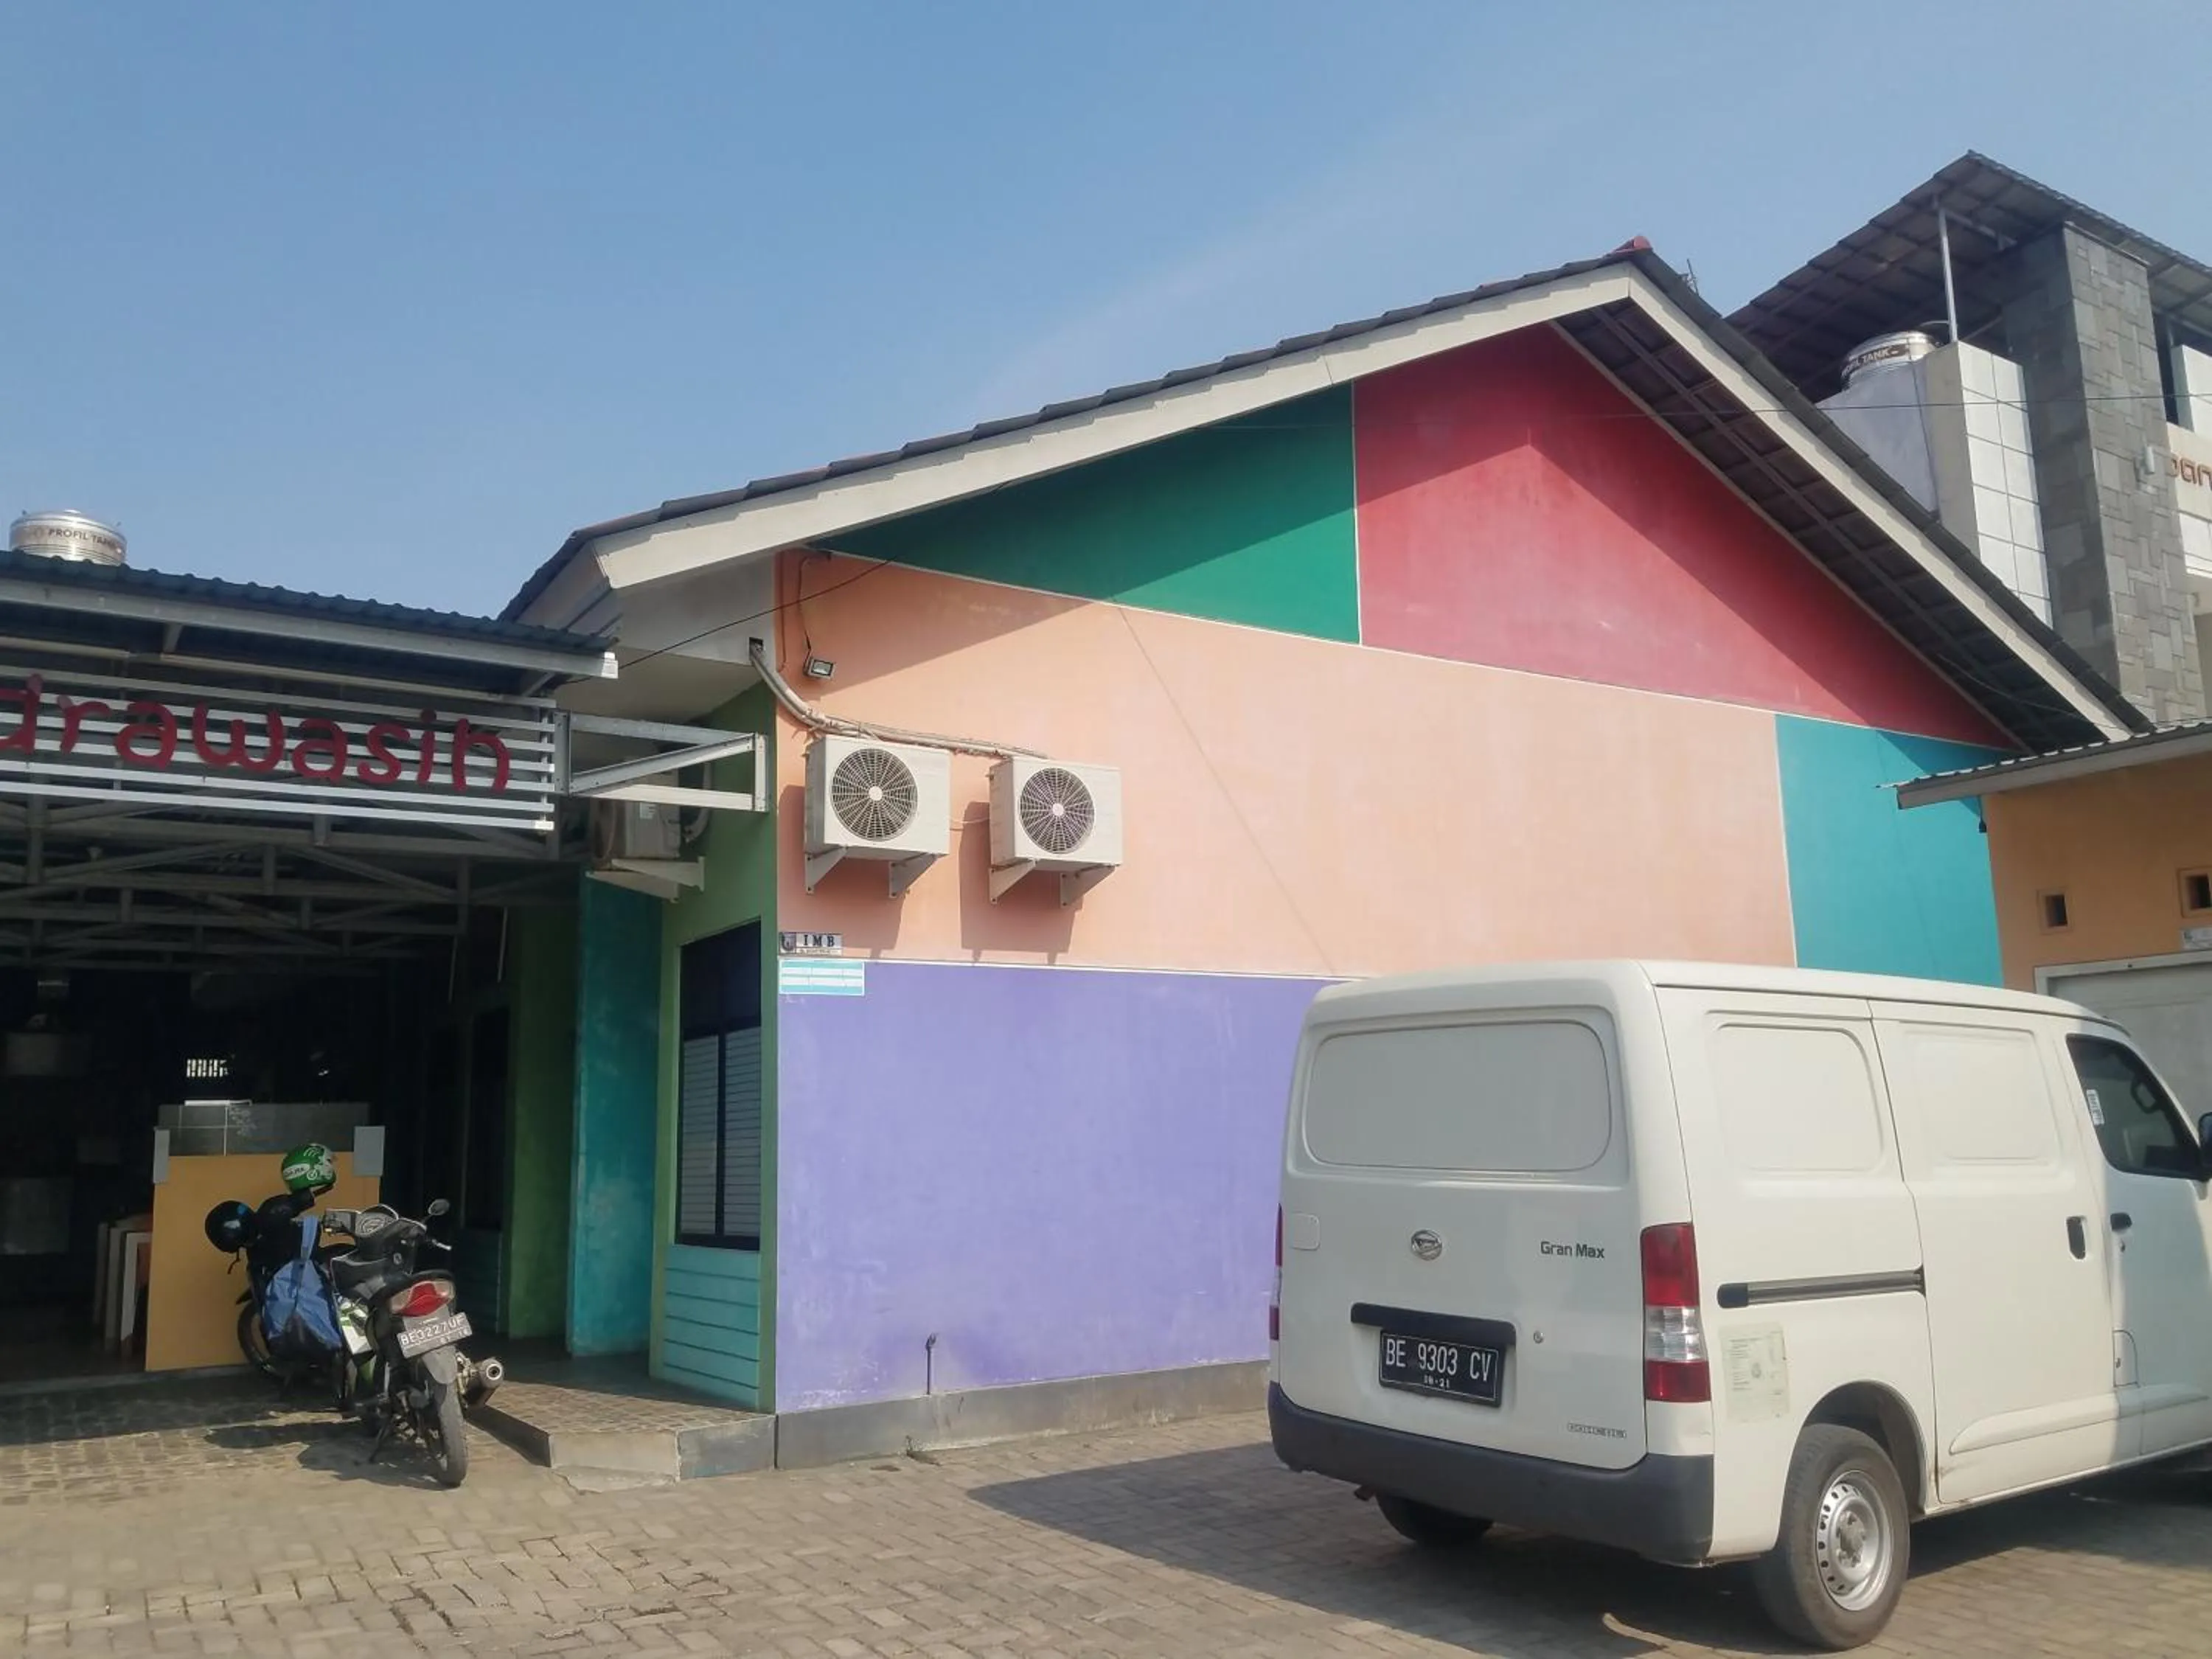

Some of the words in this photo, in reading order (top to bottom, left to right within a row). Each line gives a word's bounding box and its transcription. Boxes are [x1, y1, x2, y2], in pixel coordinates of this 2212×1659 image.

[48, 528, 89, 540] PROFIL
[1540, 1241, 1573, 1256] Gran
[1576, 1243, 1604, 1258] Max
[1386, 1339, 1406, 1367] BE
[1418, 1343, 1458, 1375] 9303
[1470, 1352, 1491, 1381] CV
